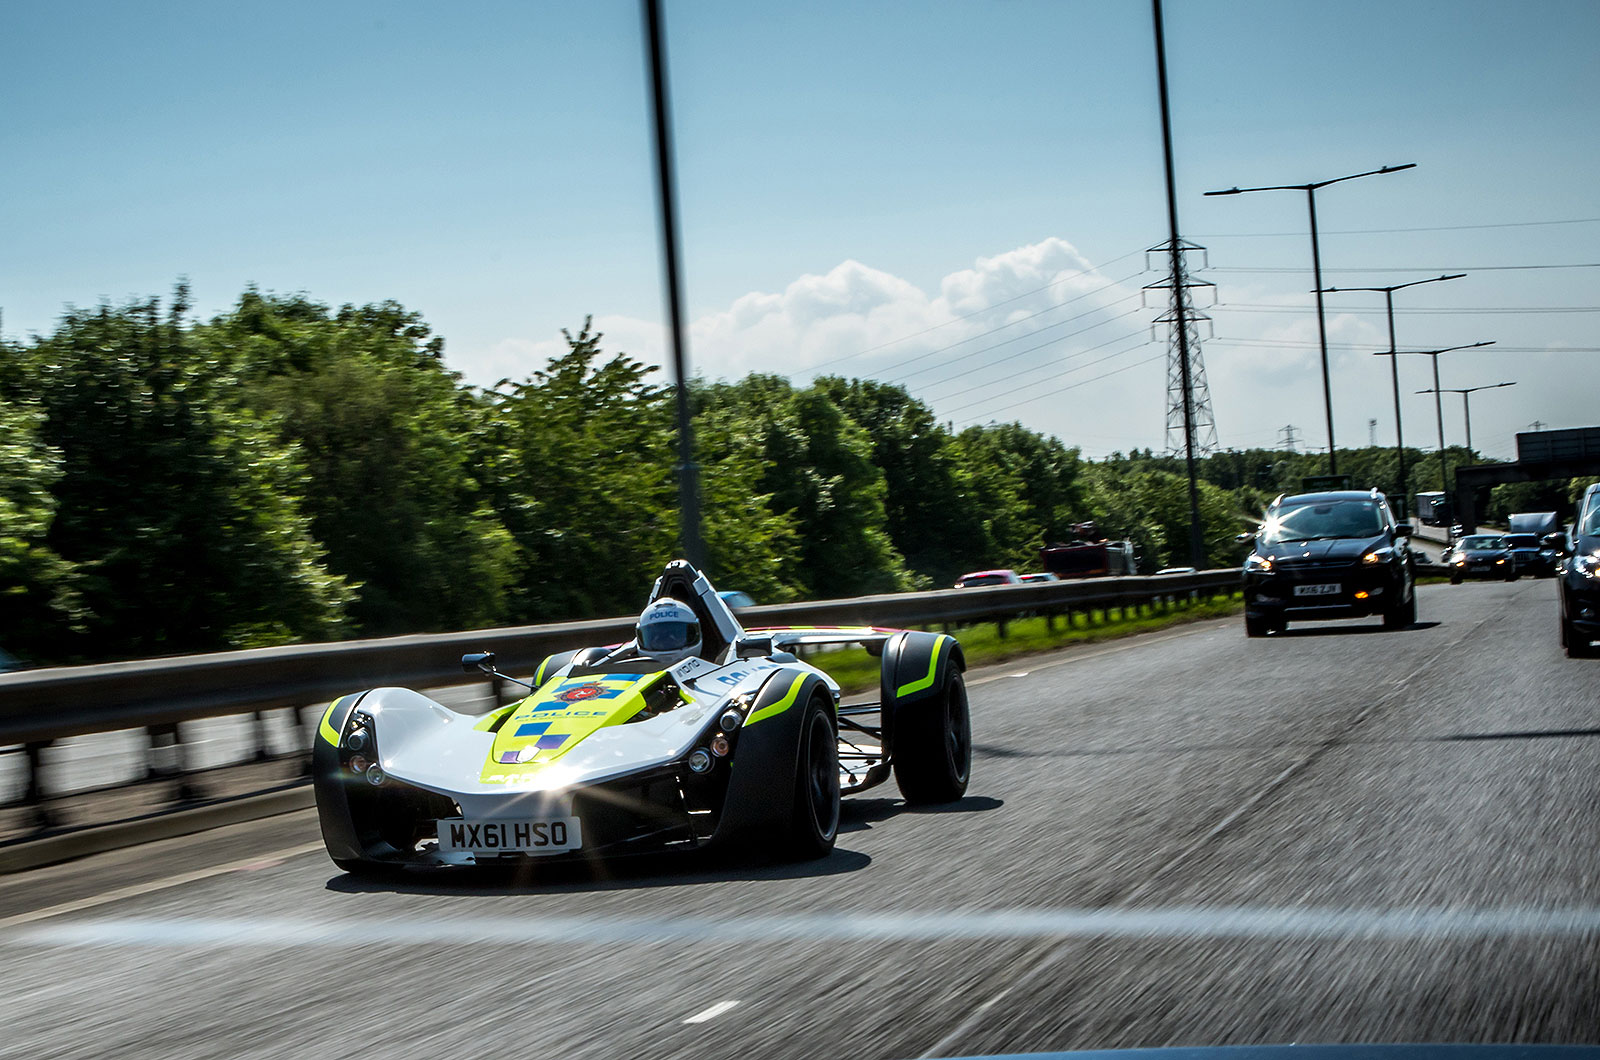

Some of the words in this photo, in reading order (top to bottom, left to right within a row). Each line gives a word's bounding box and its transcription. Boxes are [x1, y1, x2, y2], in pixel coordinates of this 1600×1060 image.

[649, 610, 679, 620] POLICE
[514, 711, 608, 721] POLICE
[450, 823, 507, 848] MX61
[514, 821, 567, 847] HSO
